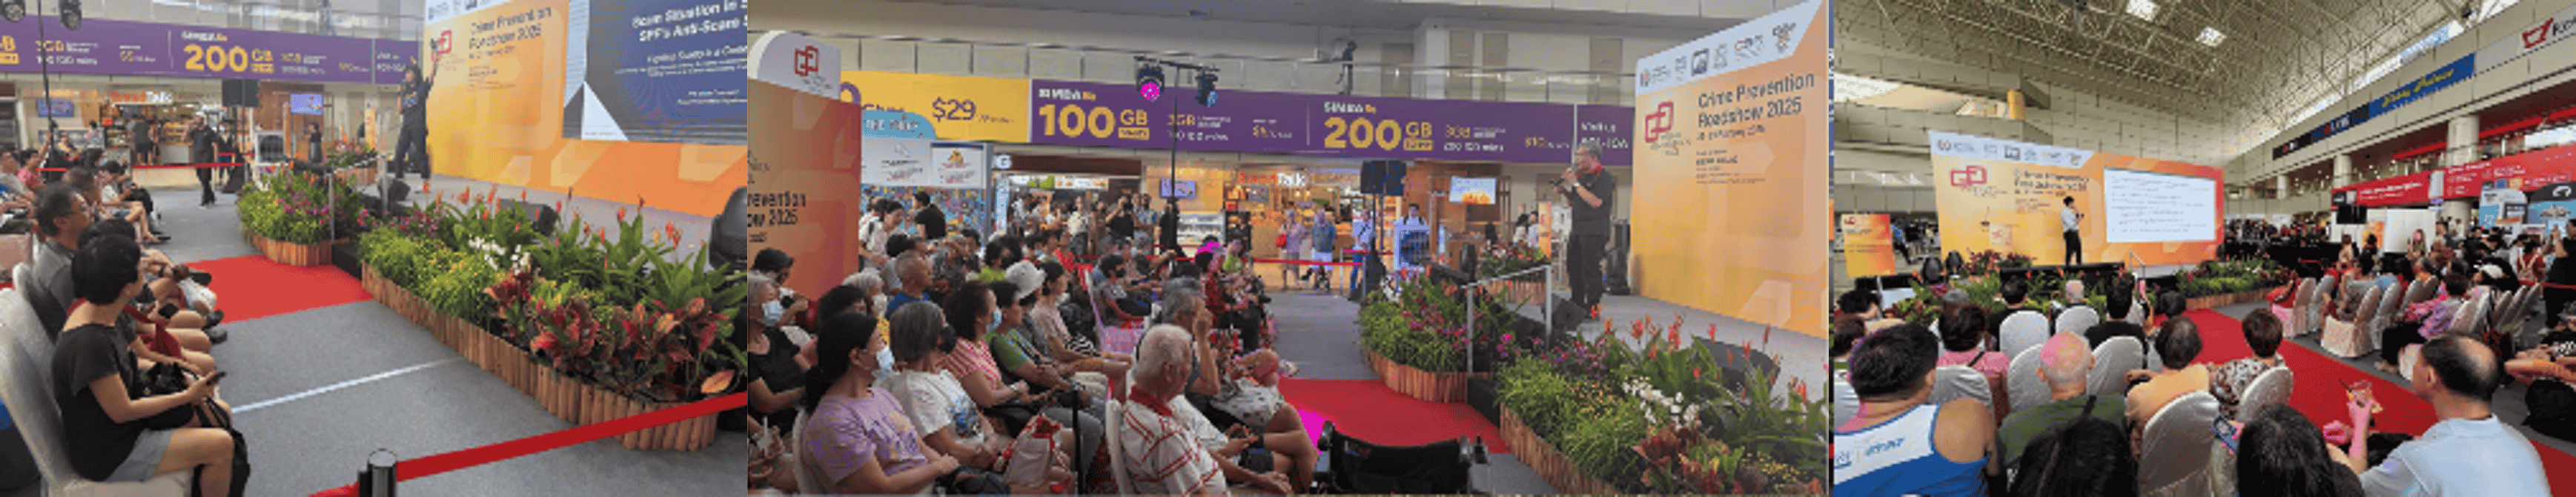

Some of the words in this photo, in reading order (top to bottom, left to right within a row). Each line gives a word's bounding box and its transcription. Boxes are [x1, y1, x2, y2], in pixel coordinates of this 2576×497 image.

[184, 43, 248, 72] 200
[251, 48, 273, 62] GB
[1698, 84, 1733, 109] Crime
[1736, 73, 1815, 102] Prevention
[933, 96, 976, 123] $29
[1039, 104, 1116, 139] 100
[1120, 109, 1148, 126] GB
[1698, 106, 1764, 128] Roadshow
[1767, 96, 1802, 118] 2025
[1324, 116, 1402, 151] 200
[1405, 122, 1432, 138] GB
